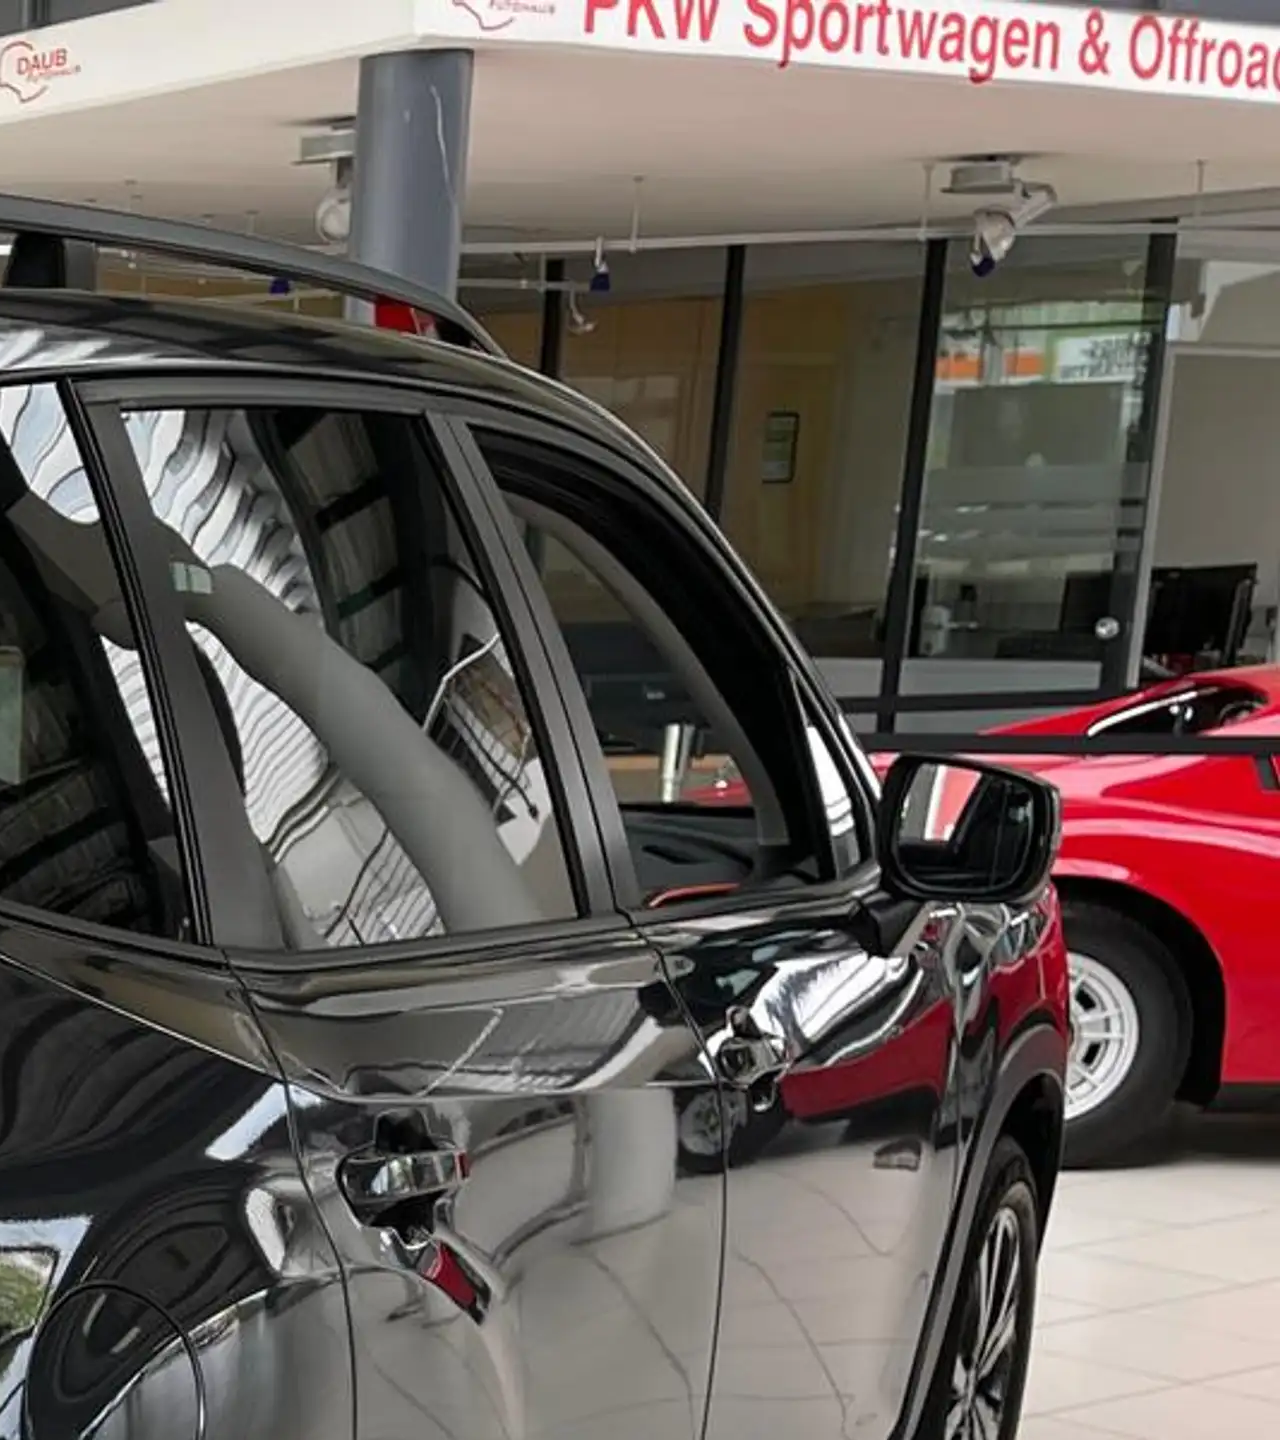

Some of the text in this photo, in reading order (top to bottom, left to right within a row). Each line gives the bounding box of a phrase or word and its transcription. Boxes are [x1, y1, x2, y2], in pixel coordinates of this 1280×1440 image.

[17, 47, 68, 75] DAUB
[743, 0, 1061, 83] Sportwagen
[1078, 8, 1111, 75] &
